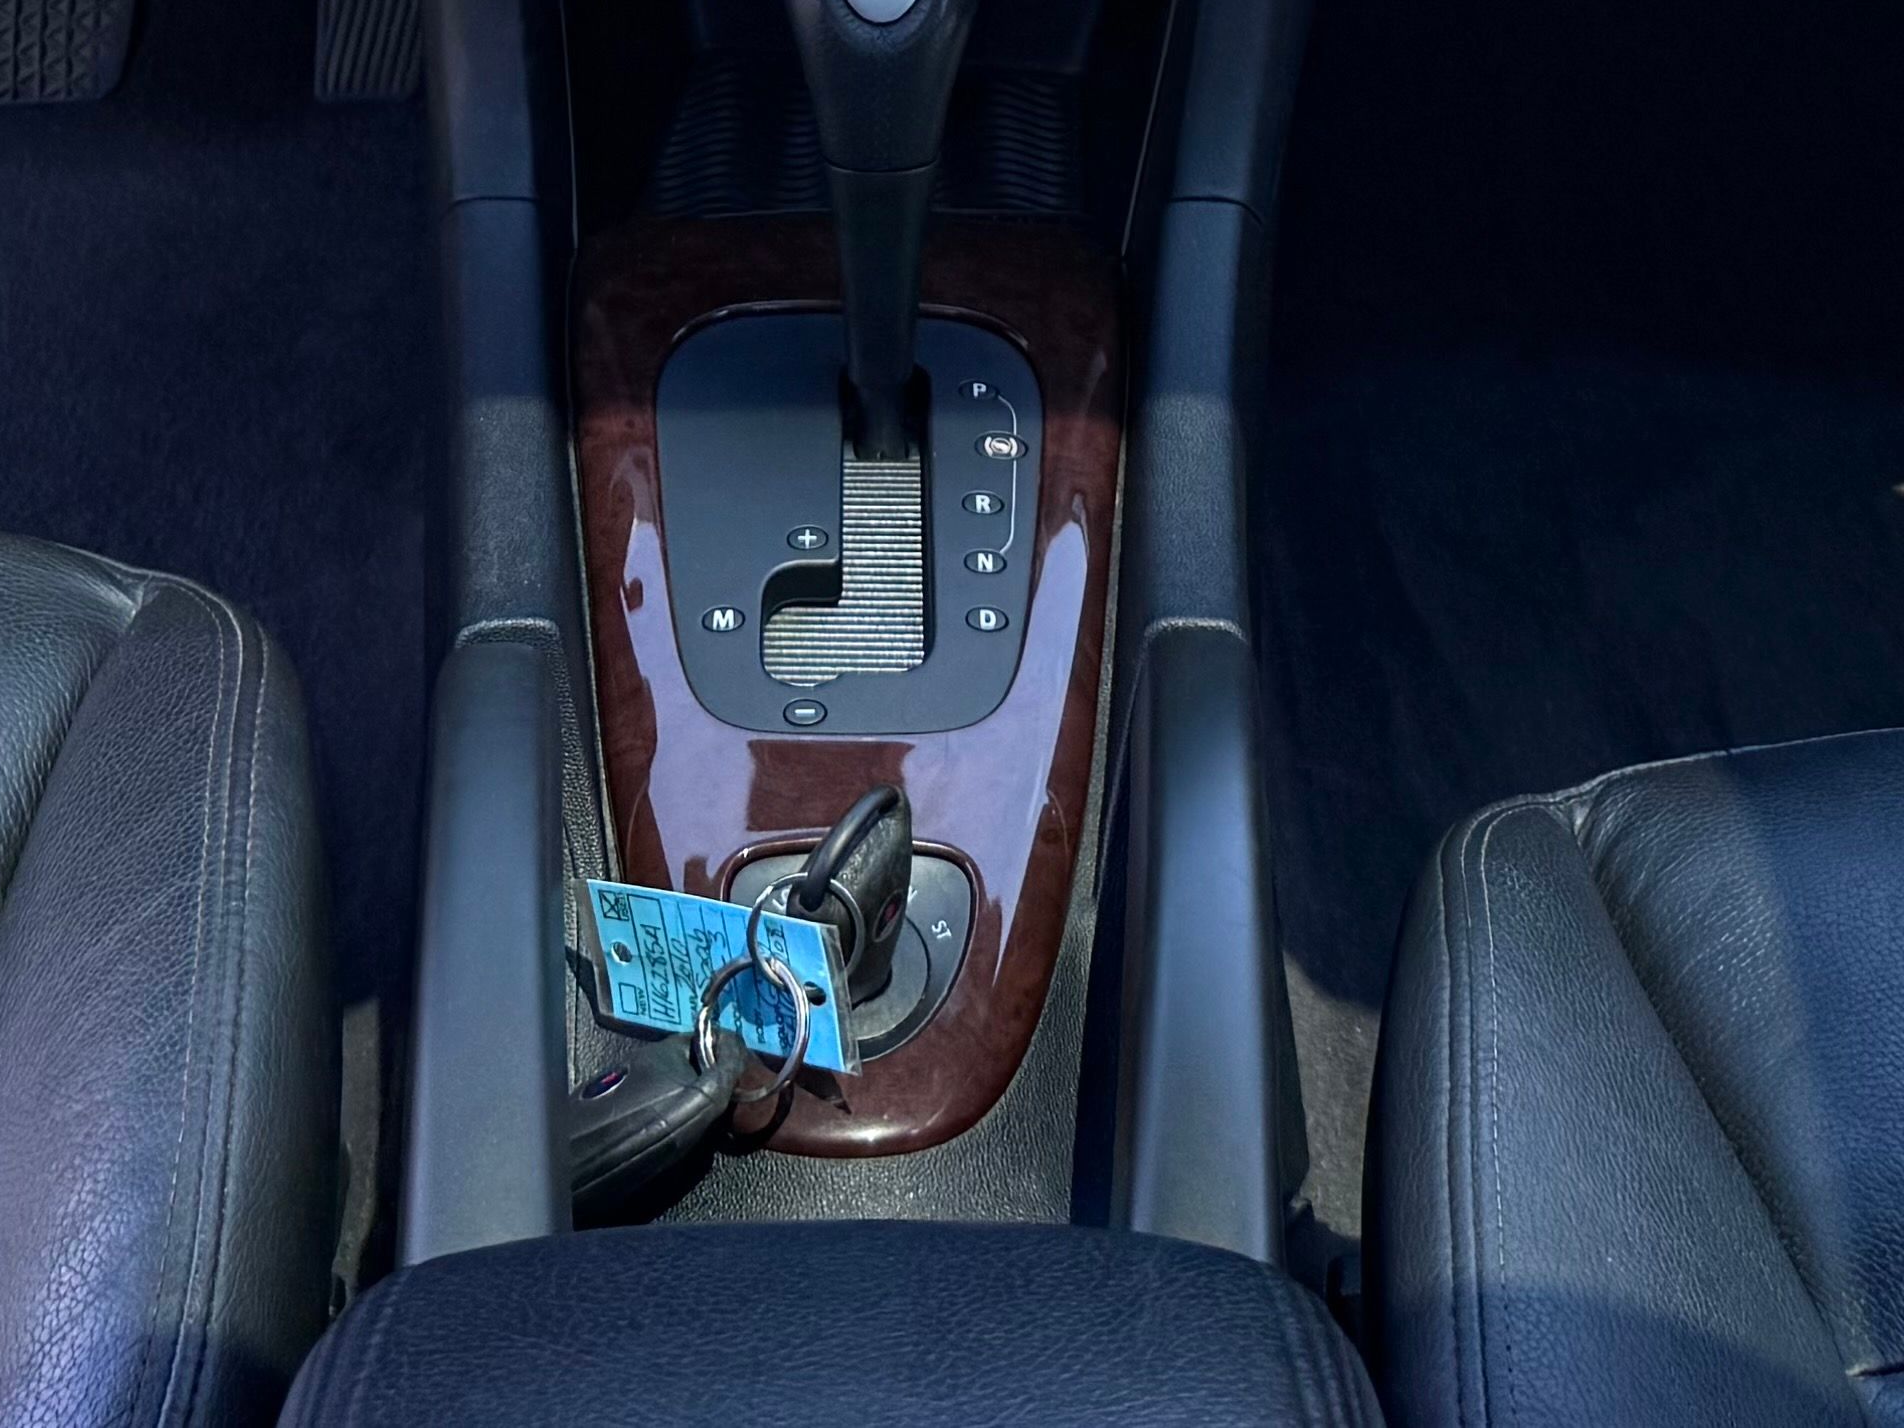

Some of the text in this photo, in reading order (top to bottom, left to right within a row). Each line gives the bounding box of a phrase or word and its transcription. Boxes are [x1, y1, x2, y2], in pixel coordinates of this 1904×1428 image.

[972, 382, 987, 398] P
[975, 495, 992, 514] R
[977, 553, 994, 573] N
[712, 609, 735, 631] M
[979, 610, 997, 631] D
